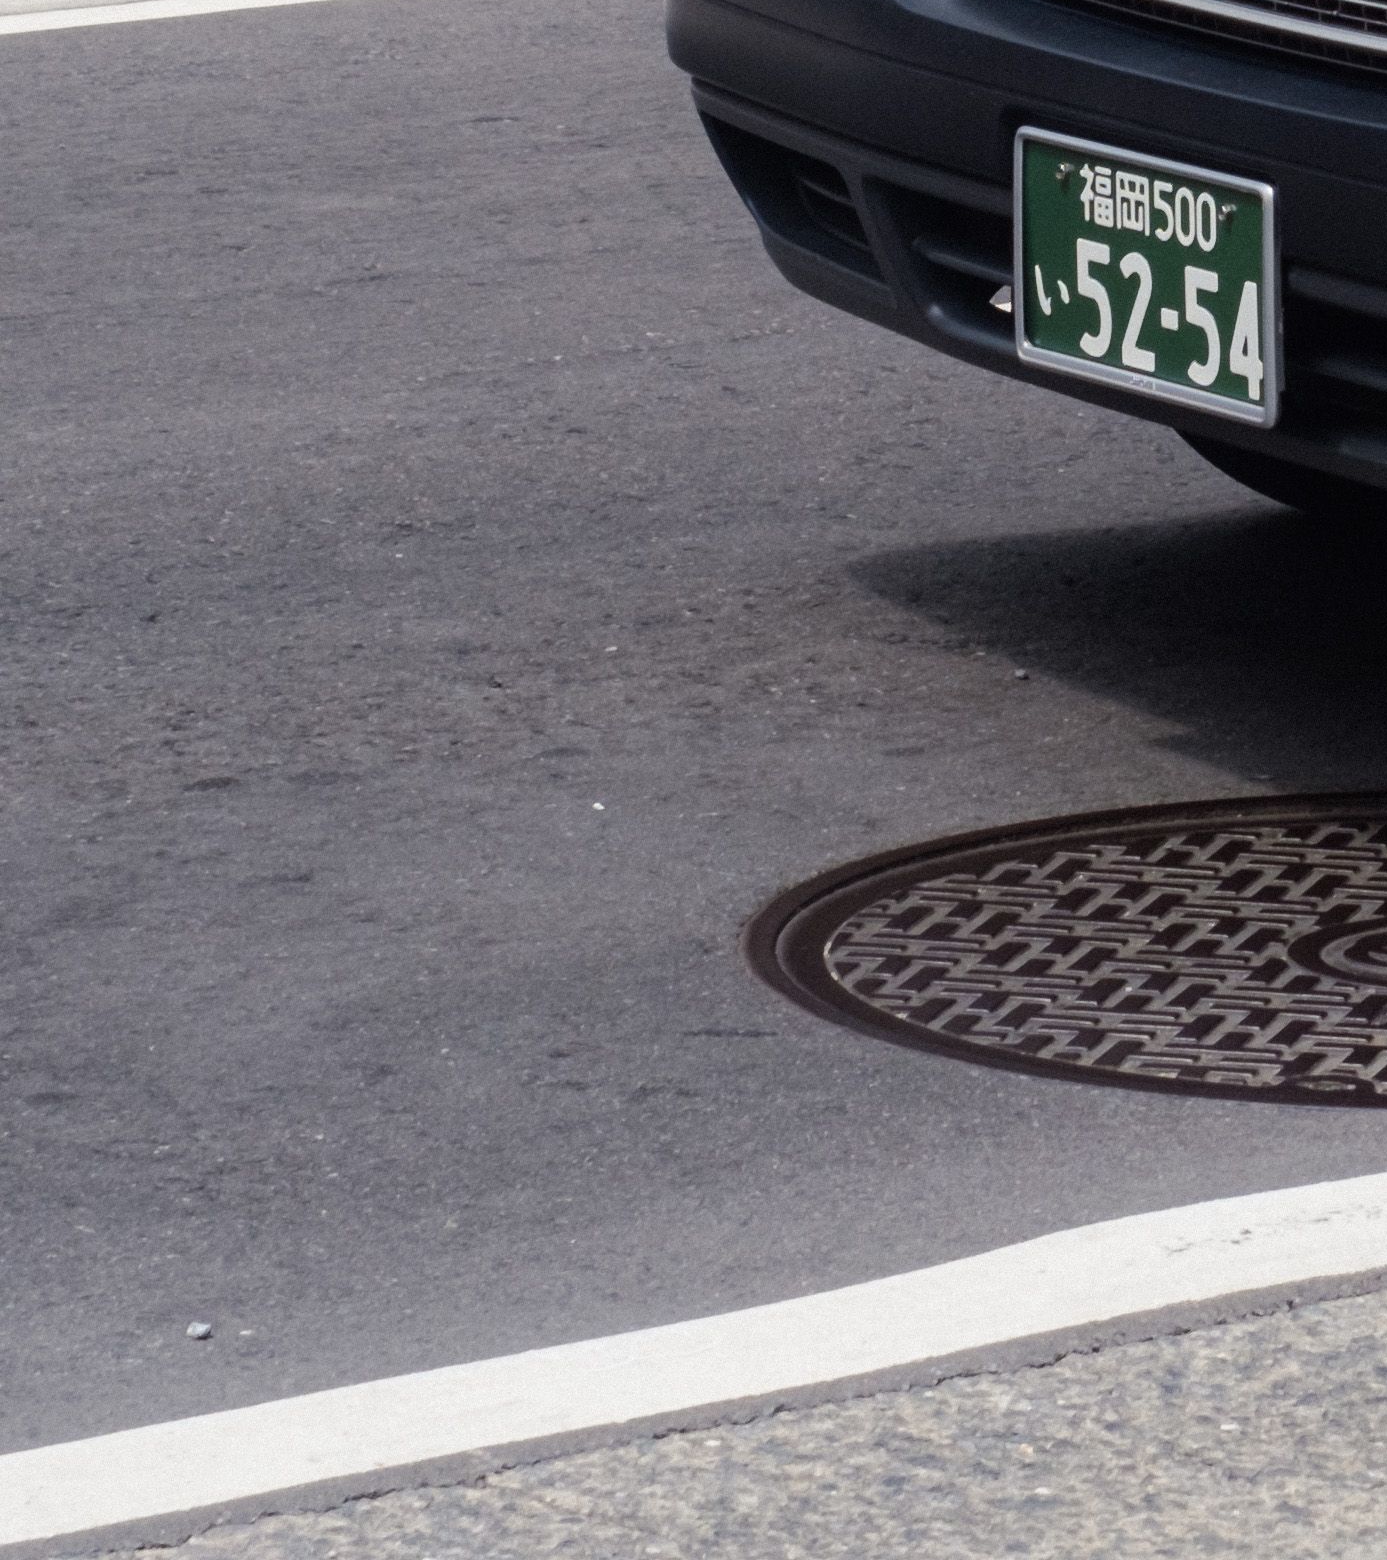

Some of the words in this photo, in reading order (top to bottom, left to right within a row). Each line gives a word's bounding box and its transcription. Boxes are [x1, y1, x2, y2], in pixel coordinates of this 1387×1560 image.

[1079, 163, 1151, 237] 福岡
[1153, 179, 1217, 253] 500
[1033, 263, 1070, 317] い
[1075, 237, 1265, 401] 52-54
